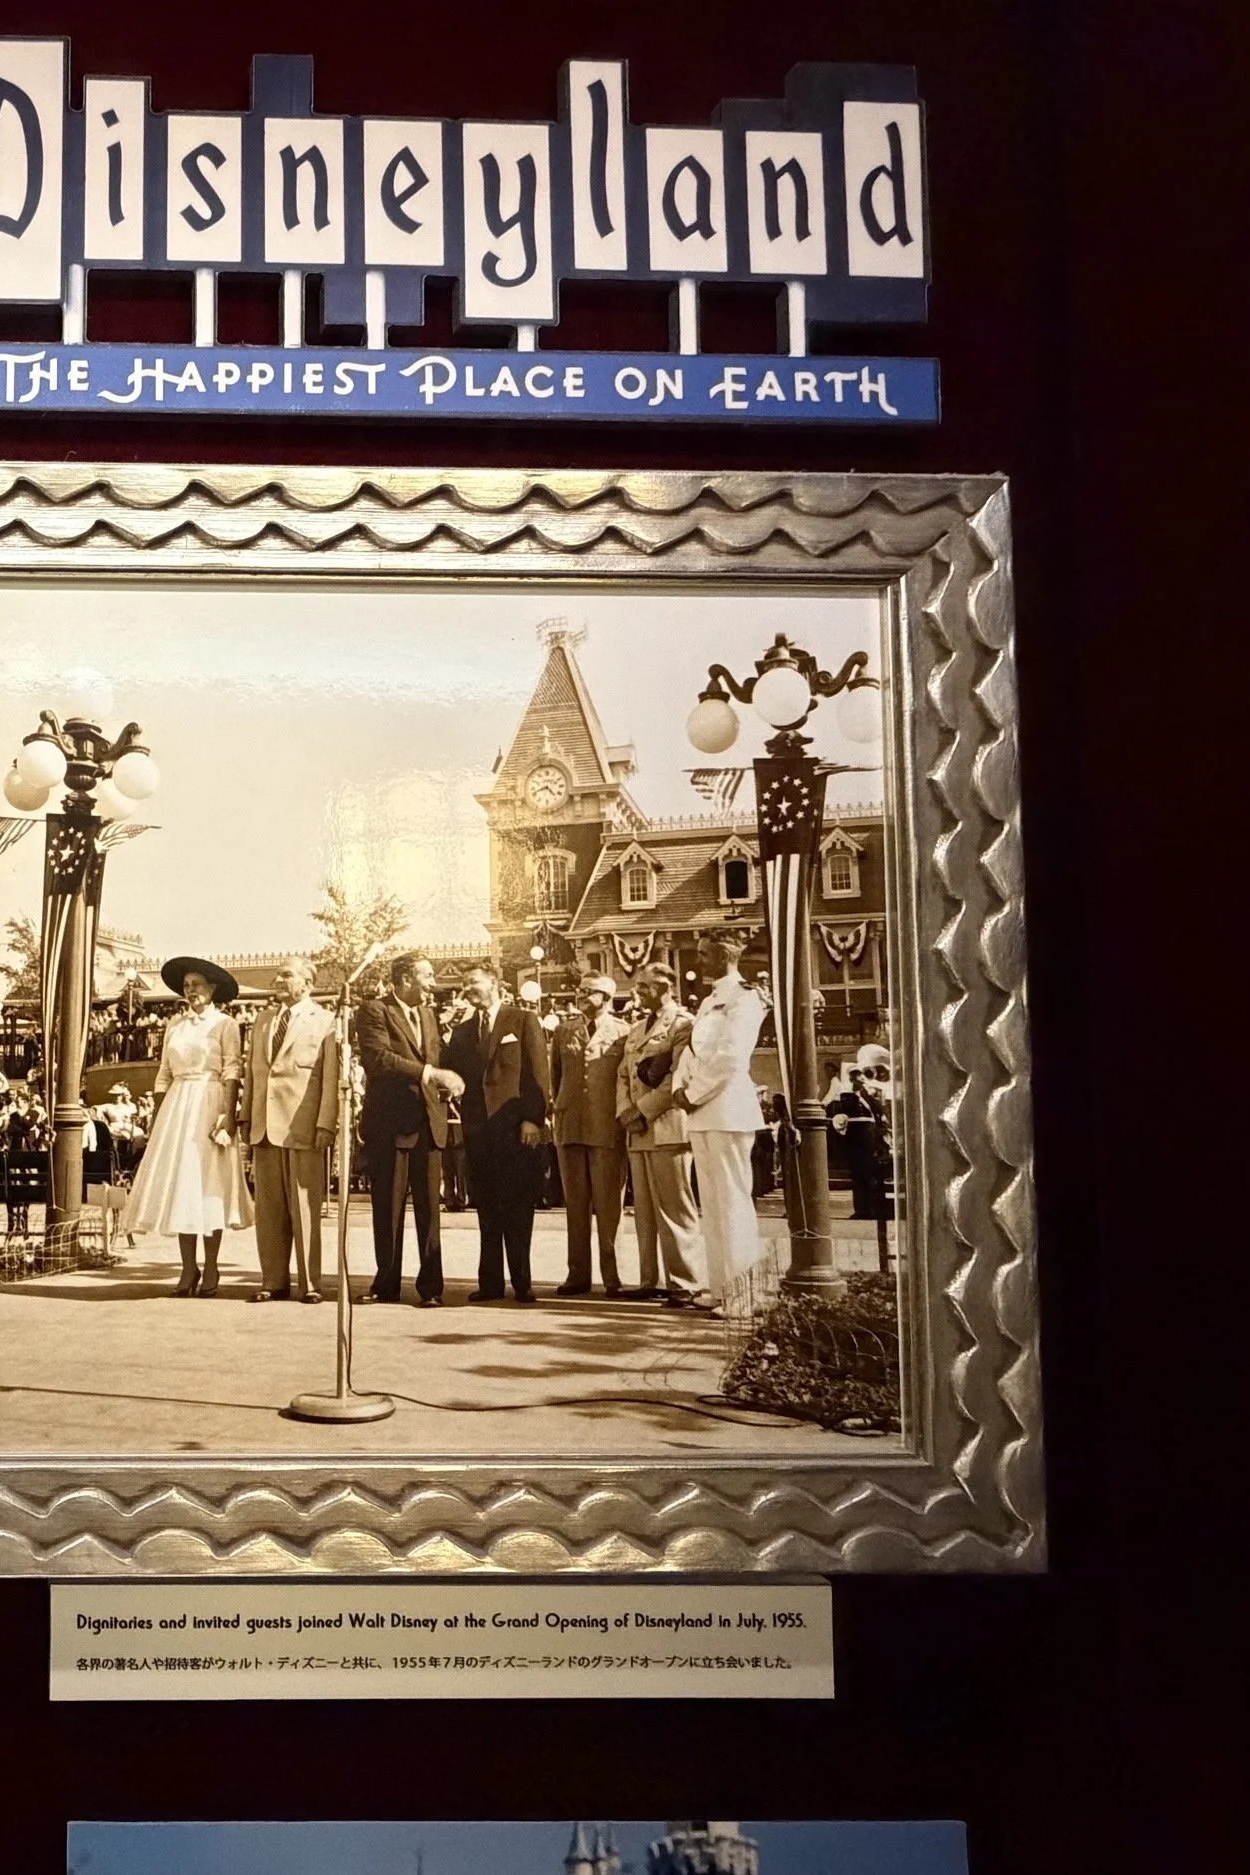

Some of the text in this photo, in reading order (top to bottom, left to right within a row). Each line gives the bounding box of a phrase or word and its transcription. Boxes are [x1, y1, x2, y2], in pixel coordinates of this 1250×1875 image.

[98, 356, 386, 403] HAPPIEST
[399, 356, 585, 405] PLACE
[616, 366, 682, 406] ON
[710, 370, 897, 415] EARTH
[76, 1613, 153, 1635] Dignitaries
[159, 1614, 187, 1629] and
[193, 1613, 240, 1629] invited
[246, 1615, 292, 1634] guests
[297, 1613, 343, 1633] joined
[348, 1613, 386, 1629] Walt
[391, 1613, 438, 1633] Disney
[444, 1615, 459, 1629] at
[464, 1613, 487, 1629] the
[492, 1612, 539, 1628] Grand
[545, 1613, 609, 1633] Opening
[614, 1613, 629, 1628] of
[635, 1613, 713, 1632] Disneyland
[719, 1613, 731, 1628] in
[773, 1612, 807, 1628] 1955.
